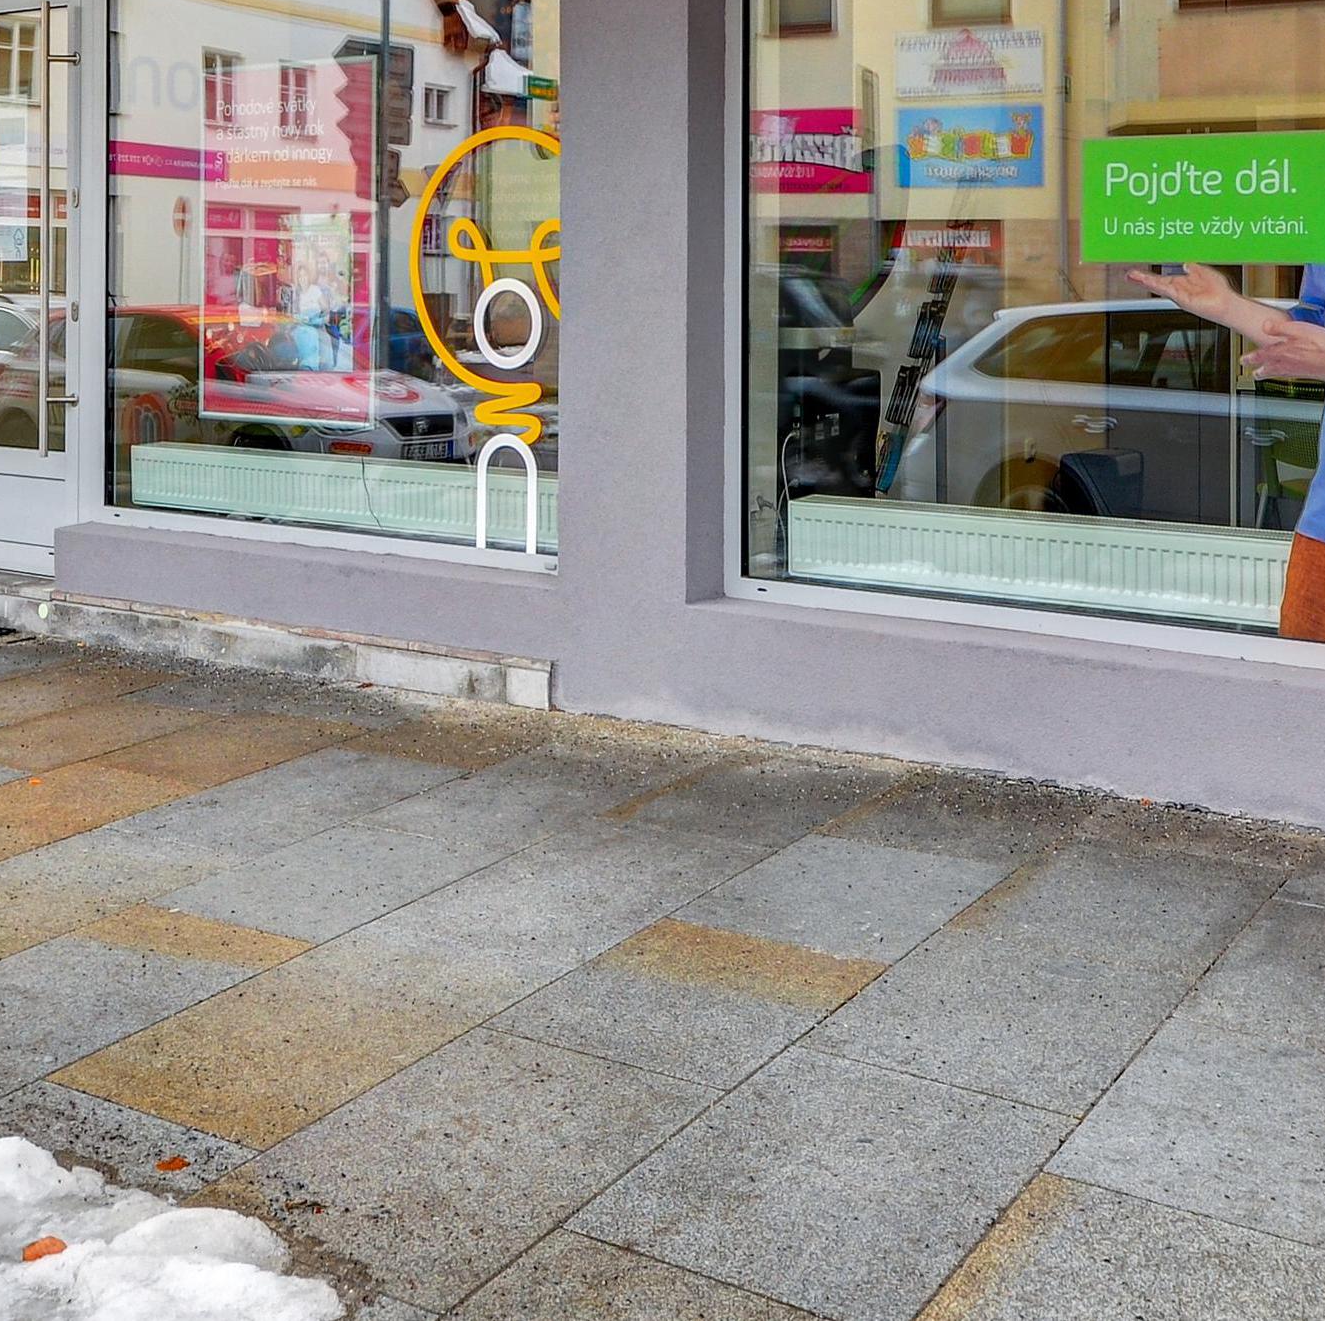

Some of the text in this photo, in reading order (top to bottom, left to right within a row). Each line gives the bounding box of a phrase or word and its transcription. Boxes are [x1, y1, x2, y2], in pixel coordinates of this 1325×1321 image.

[215, 95, 317, 119] Pohodové svátky
[216, 130, 224, 141] a
[272, 121, 302, 138] nový
[304, 119, 325, 134] rok
[226, 148, 270, 164] dárkem
[273, 148, 290, 162] od
[291, 146, 333, 164] innogy
[1105, 158, 1298, 205] Pojďte dál.
[1104, 215, 1309, 239] U nás jste vždy vítáni.
